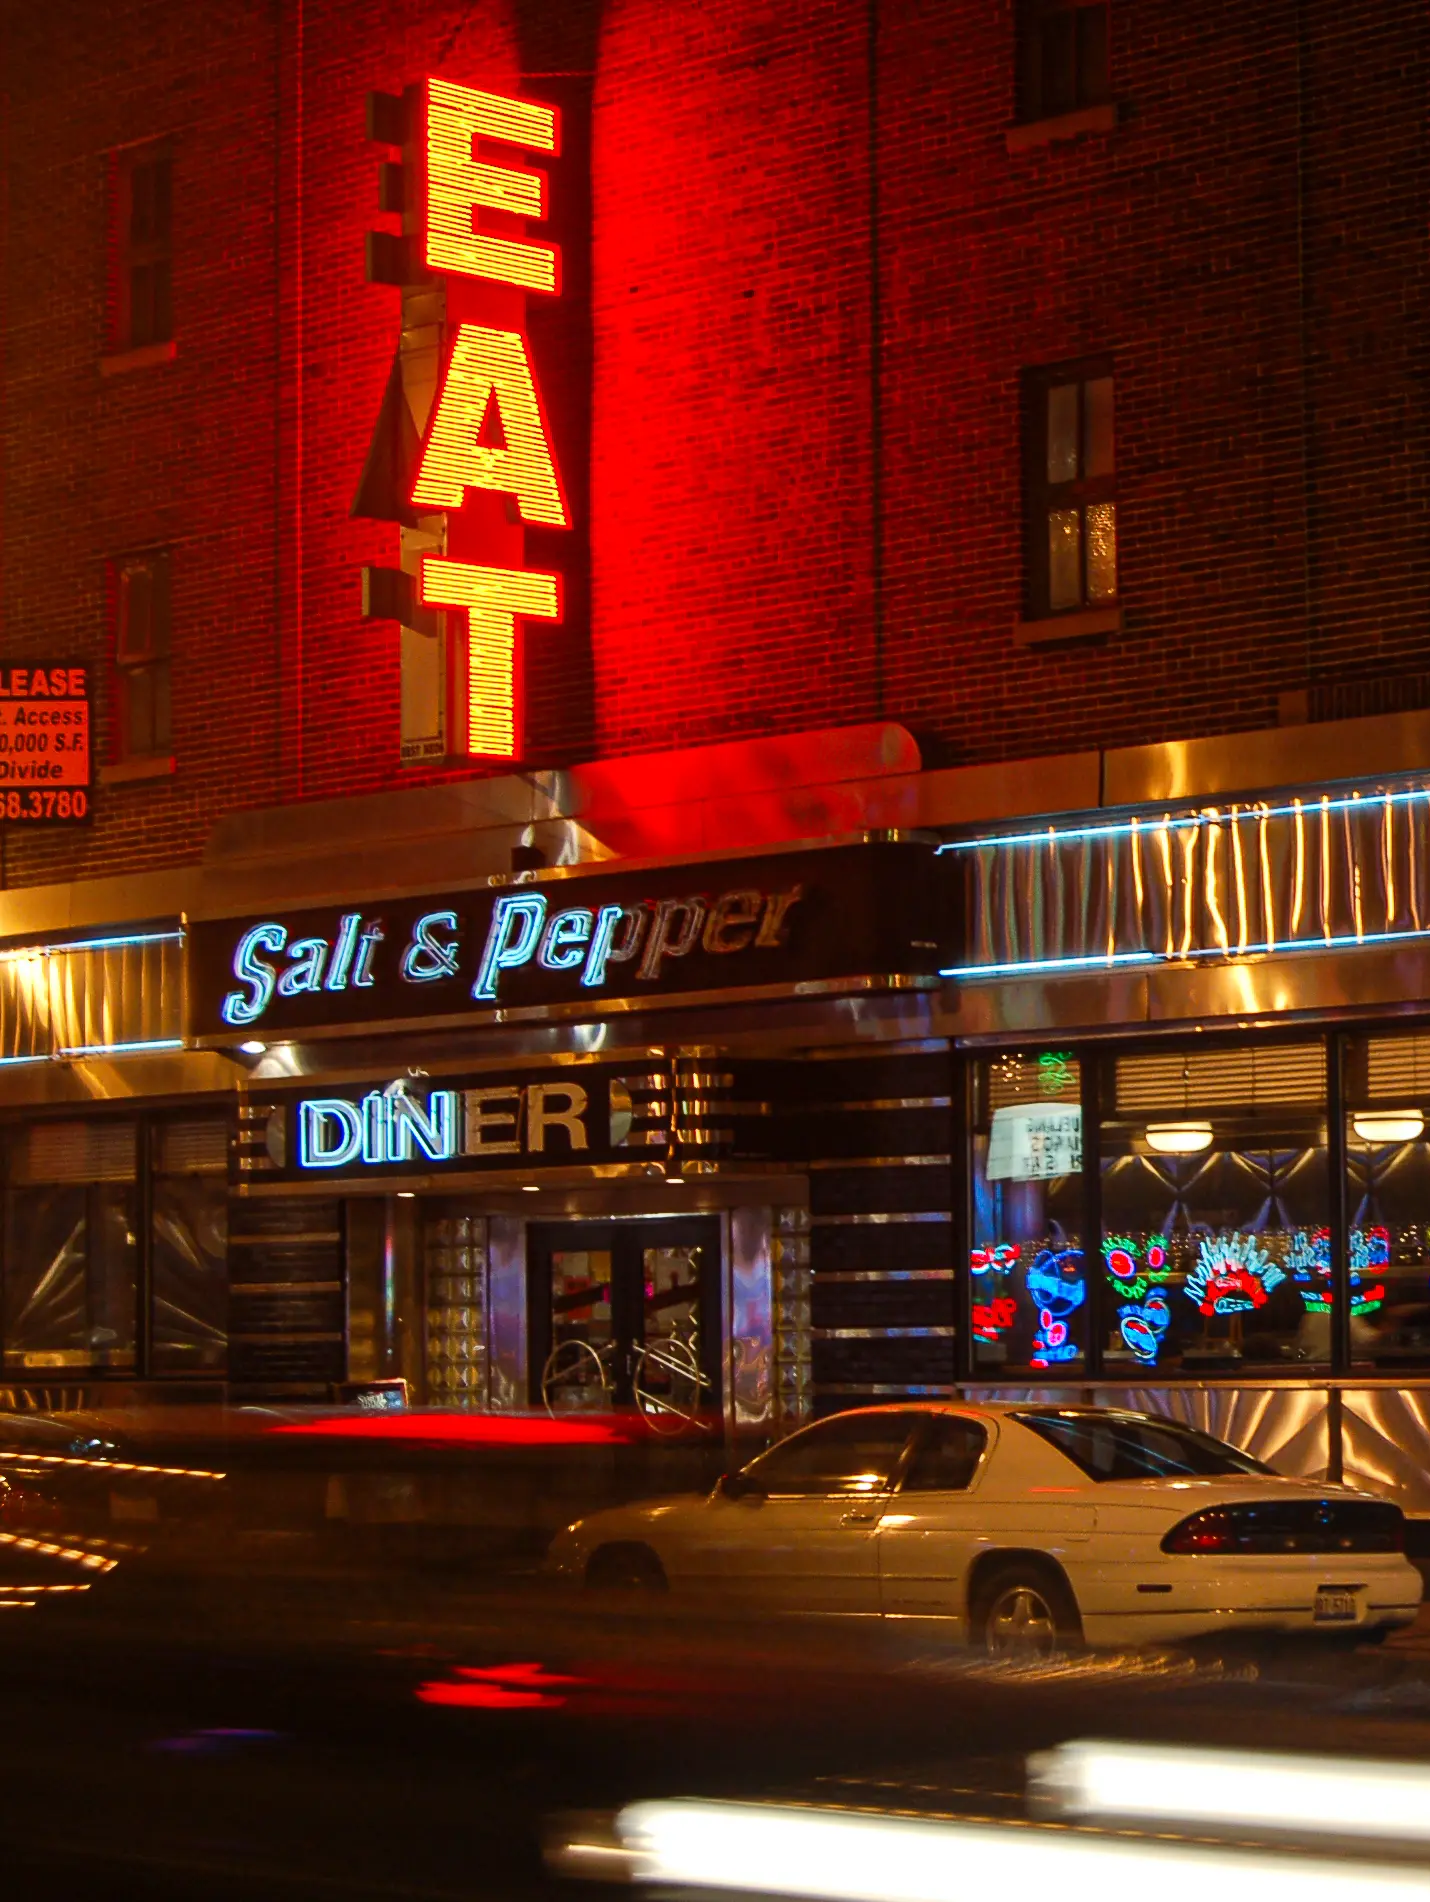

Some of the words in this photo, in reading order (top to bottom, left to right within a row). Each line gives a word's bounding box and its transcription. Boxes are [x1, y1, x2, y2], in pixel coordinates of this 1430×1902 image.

[411, 76, 573, 759] EAT
[0, 669, 86, 697] LEASE
[14, 706, 83, 726] Access
[0, 761, 63, 779] Divide
[222, 912, 386, 1025] Salt
[404, 910, 461, 984] &
[472, 883, 802, 999] Pepper
[300, 1082, 590, 1168] DINER
